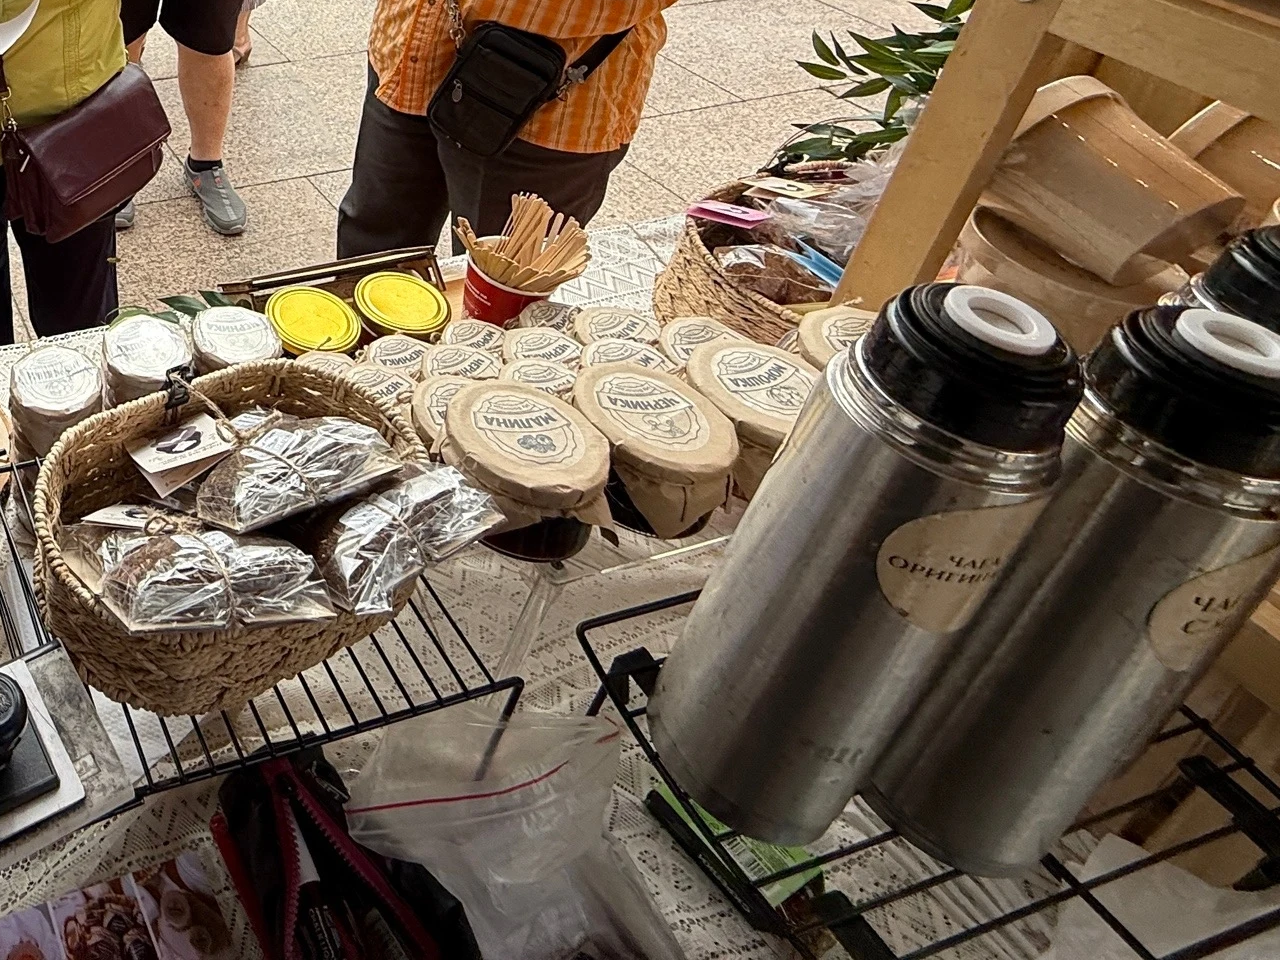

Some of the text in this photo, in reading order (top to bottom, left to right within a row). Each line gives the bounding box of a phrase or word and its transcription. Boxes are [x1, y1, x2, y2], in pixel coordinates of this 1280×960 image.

[206, 322, 260, 333] ЧЕРНИКА
[380, 349, 425, 366] ЧЕРНИКА
[727, 363, 787, 387] МОРОШКА
[607, 395, 680, 411] ЧЕРНИКА
[483, 413, 557, 429] МАЛИНА
